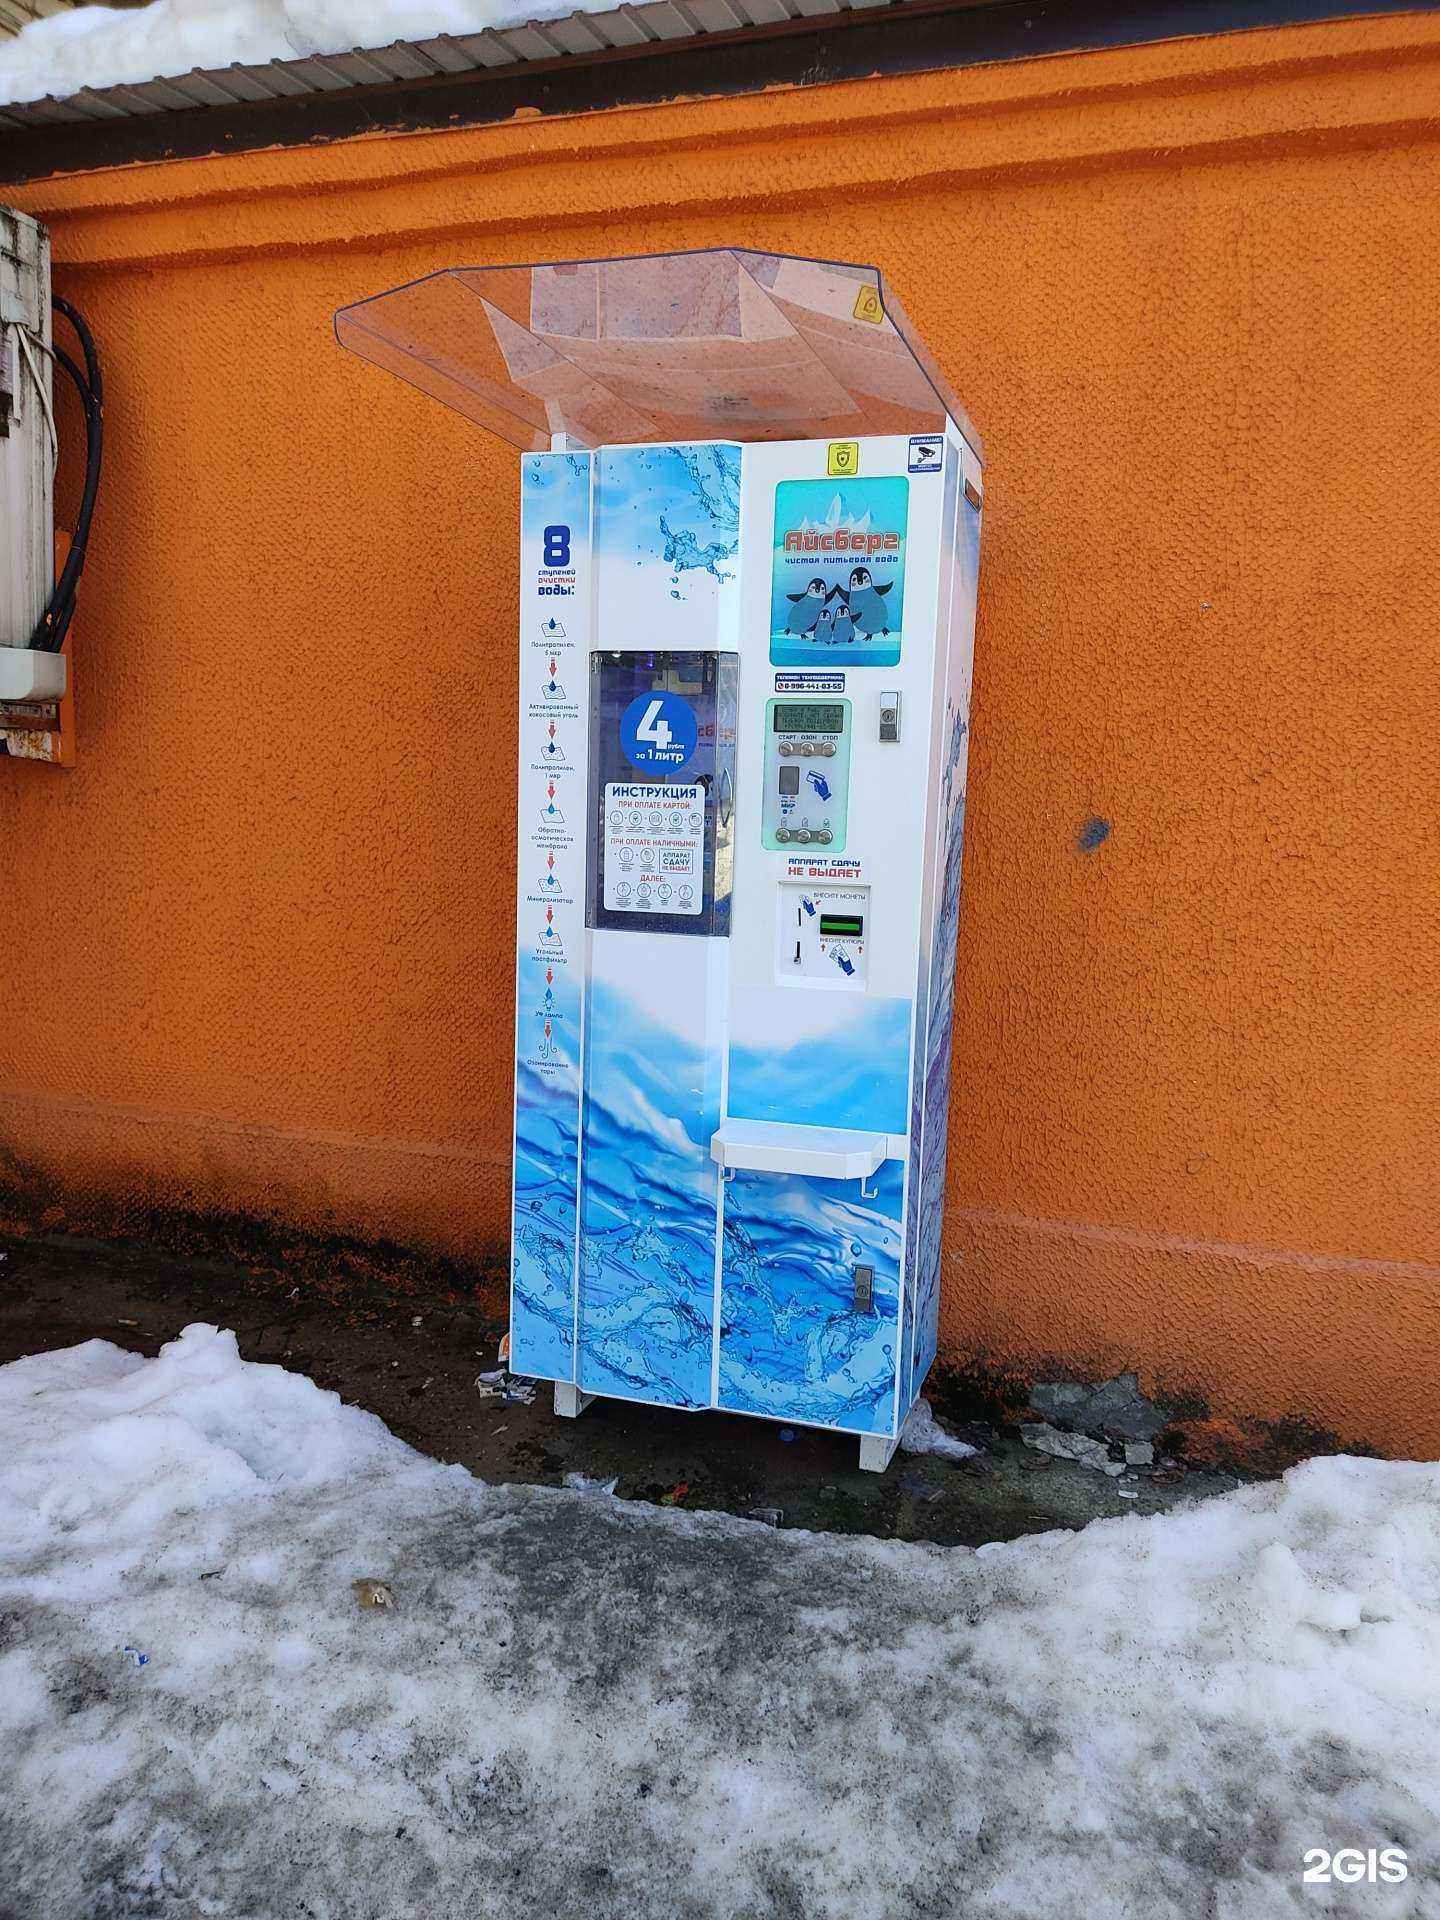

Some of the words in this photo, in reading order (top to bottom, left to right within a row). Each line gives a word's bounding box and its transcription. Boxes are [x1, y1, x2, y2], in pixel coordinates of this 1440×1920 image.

[544, 525, 570, 567] 8
[784, 527, 900, 554] Айсберг
[785, 557, 820, 565] чистая
[823, 556, 872, 564] питьевая
[875, 554, 899, 563] вода
[538, 569, 576, 577] ступеней
[538, 585, 575, 595] воды:
[636, 700, 673, 750] 4
[648, 749, 653, 759] 1
[655, 752, 684, 763] литр
[612, 786, 697, 800] ИНСТРУКЦИЯ
[635, 801, 661, 809] ОПЛАТЕ
[626, 838, 651, 846] ОПЛАТЕ
[788, 858, 827, 867] АППАРАТ
[831, 860, 861, 868] СДАЧУ
[788, 867, 804, 876] НЕ
[808, 868, 861, 878] ВЫДАЕТ
